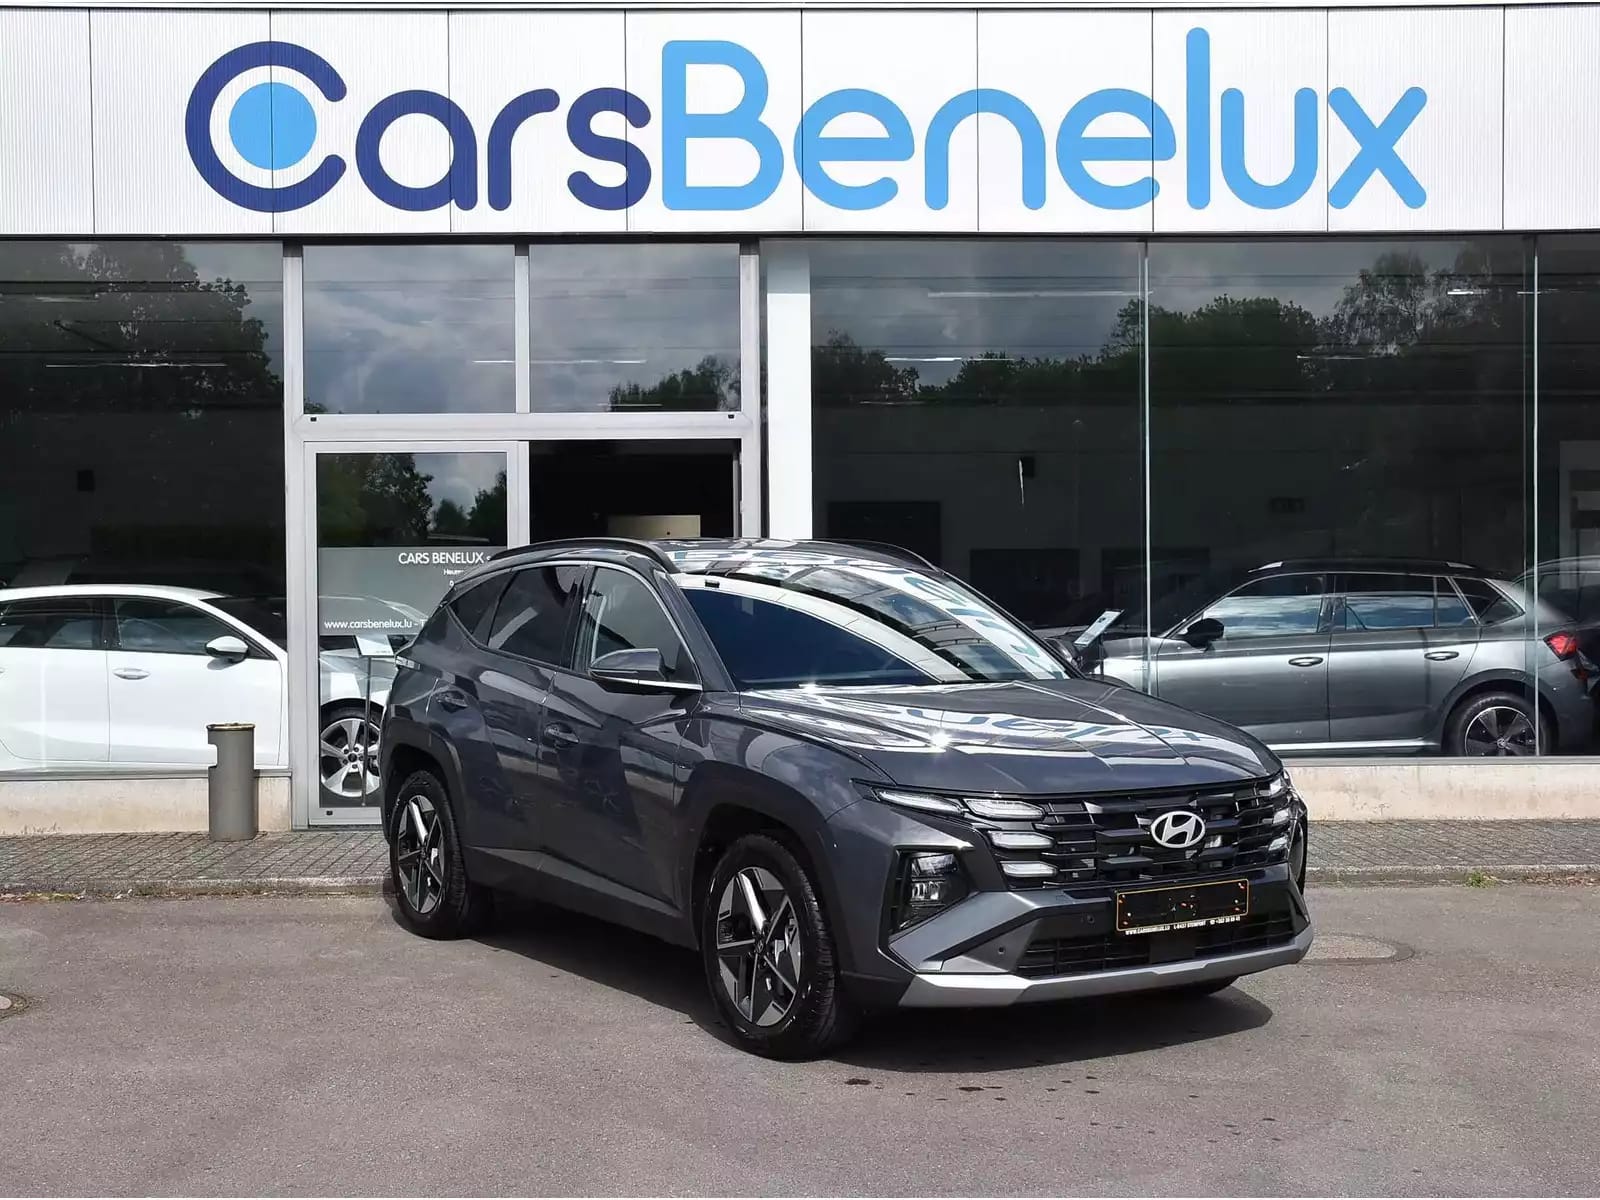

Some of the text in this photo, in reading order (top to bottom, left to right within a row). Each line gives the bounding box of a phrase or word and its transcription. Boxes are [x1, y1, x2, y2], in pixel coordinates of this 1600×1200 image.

[185, 26, 1427, 213] CarsBenelux
[398, 552, 429, 564] CARS
[432, 552, 484, 564] BENELUX
[324, 619, 412, 629] www.carsbenelux.lu
